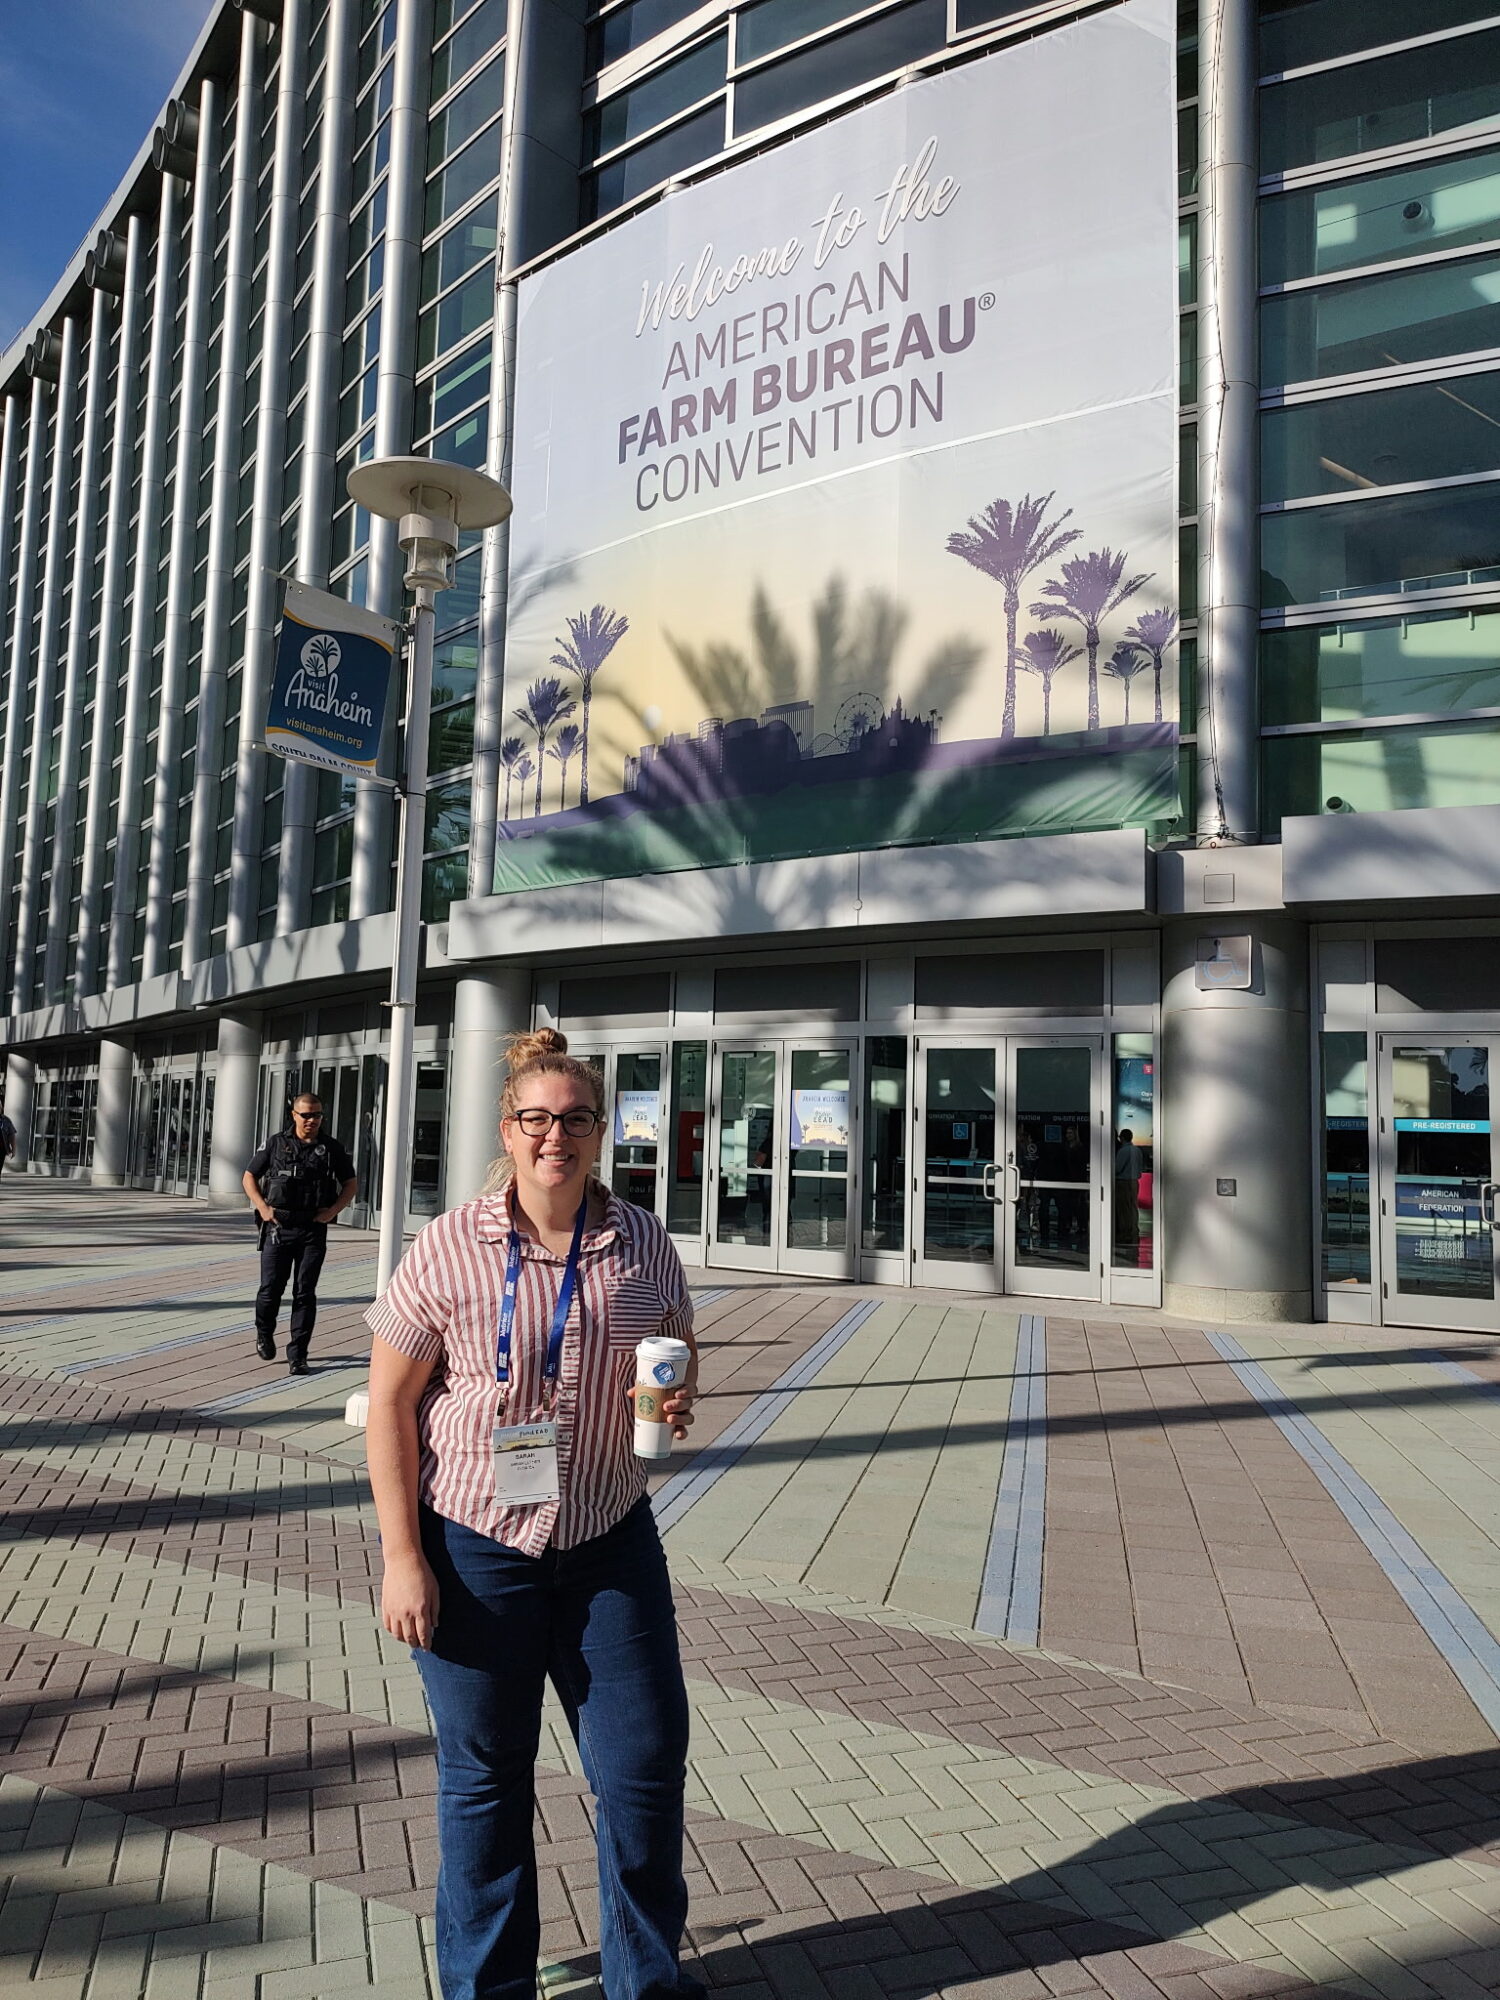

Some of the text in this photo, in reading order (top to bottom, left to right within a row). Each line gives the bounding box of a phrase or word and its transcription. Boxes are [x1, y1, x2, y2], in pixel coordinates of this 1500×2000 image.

[635, 135, 961, 338] Welcome to the
[661, 252, 910, 391] AMERICAN
[618, 377, 737, 465] FARM
[636, 370, 944, 512] CONVENTION
[284, 668, 373, 727] Anaheim
[307, 678, 326, 692] visit
[286, 717, 363, 749] visitanaheim.org
[1412, 1121, 1476, 1130] PRE-REGISTERED
[1419, 1203, 1464, 1213] FEDERATION
[1421, 1189, 1460, 1198] AMERICAN
[499, 1313, 507, 1337] Nutrien
